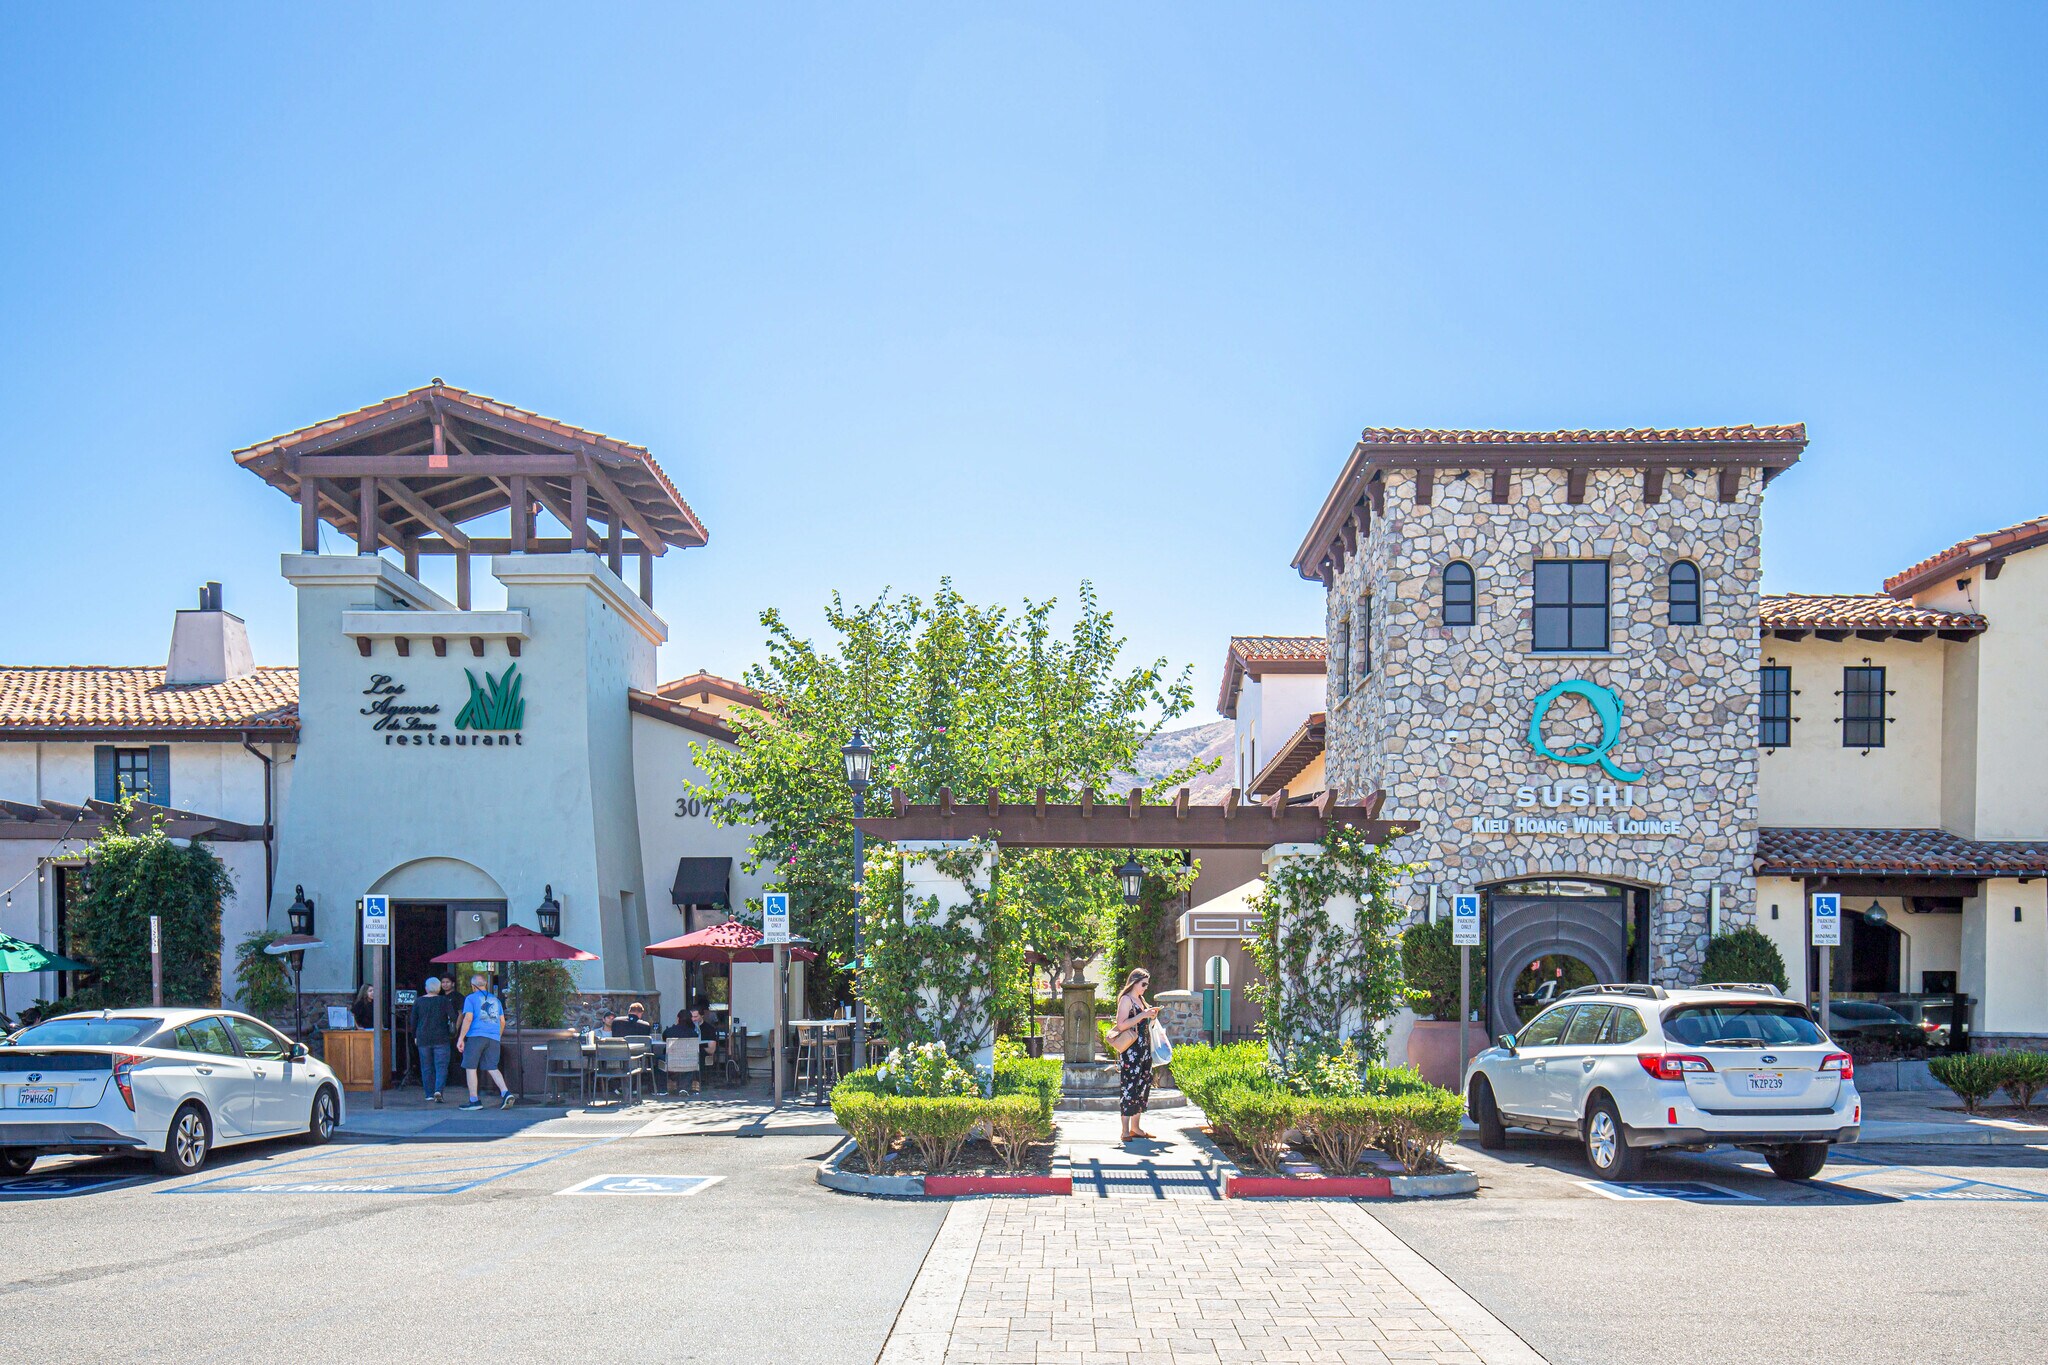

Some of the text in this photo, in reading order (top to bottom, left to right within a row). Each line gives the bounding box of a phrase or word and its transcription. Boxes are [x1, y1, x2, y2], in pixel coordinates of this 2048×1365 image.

[363, 674, 405, 694] Los
[360, 695, 440, 731] Agaves
[386, 716, 437, 730] de Luna
[1527, 679, 1645, 782] Q
[385, 732, 522, 746] restaurant
[1516, 785, 1634, 807] SUSHI
[1515, 817, 1567, 833] HOANG
[1573, 817, 1613, 833] WINE
[1618, 818, 1681, 834] LOUNGE
[472, 914, 480, 922] G
[1749, 1078, 1783, 1089] 7KZP239
[21, 1094, 53, 1104] 7PWH660
[287, 1184, 395, 1192] PARKING
